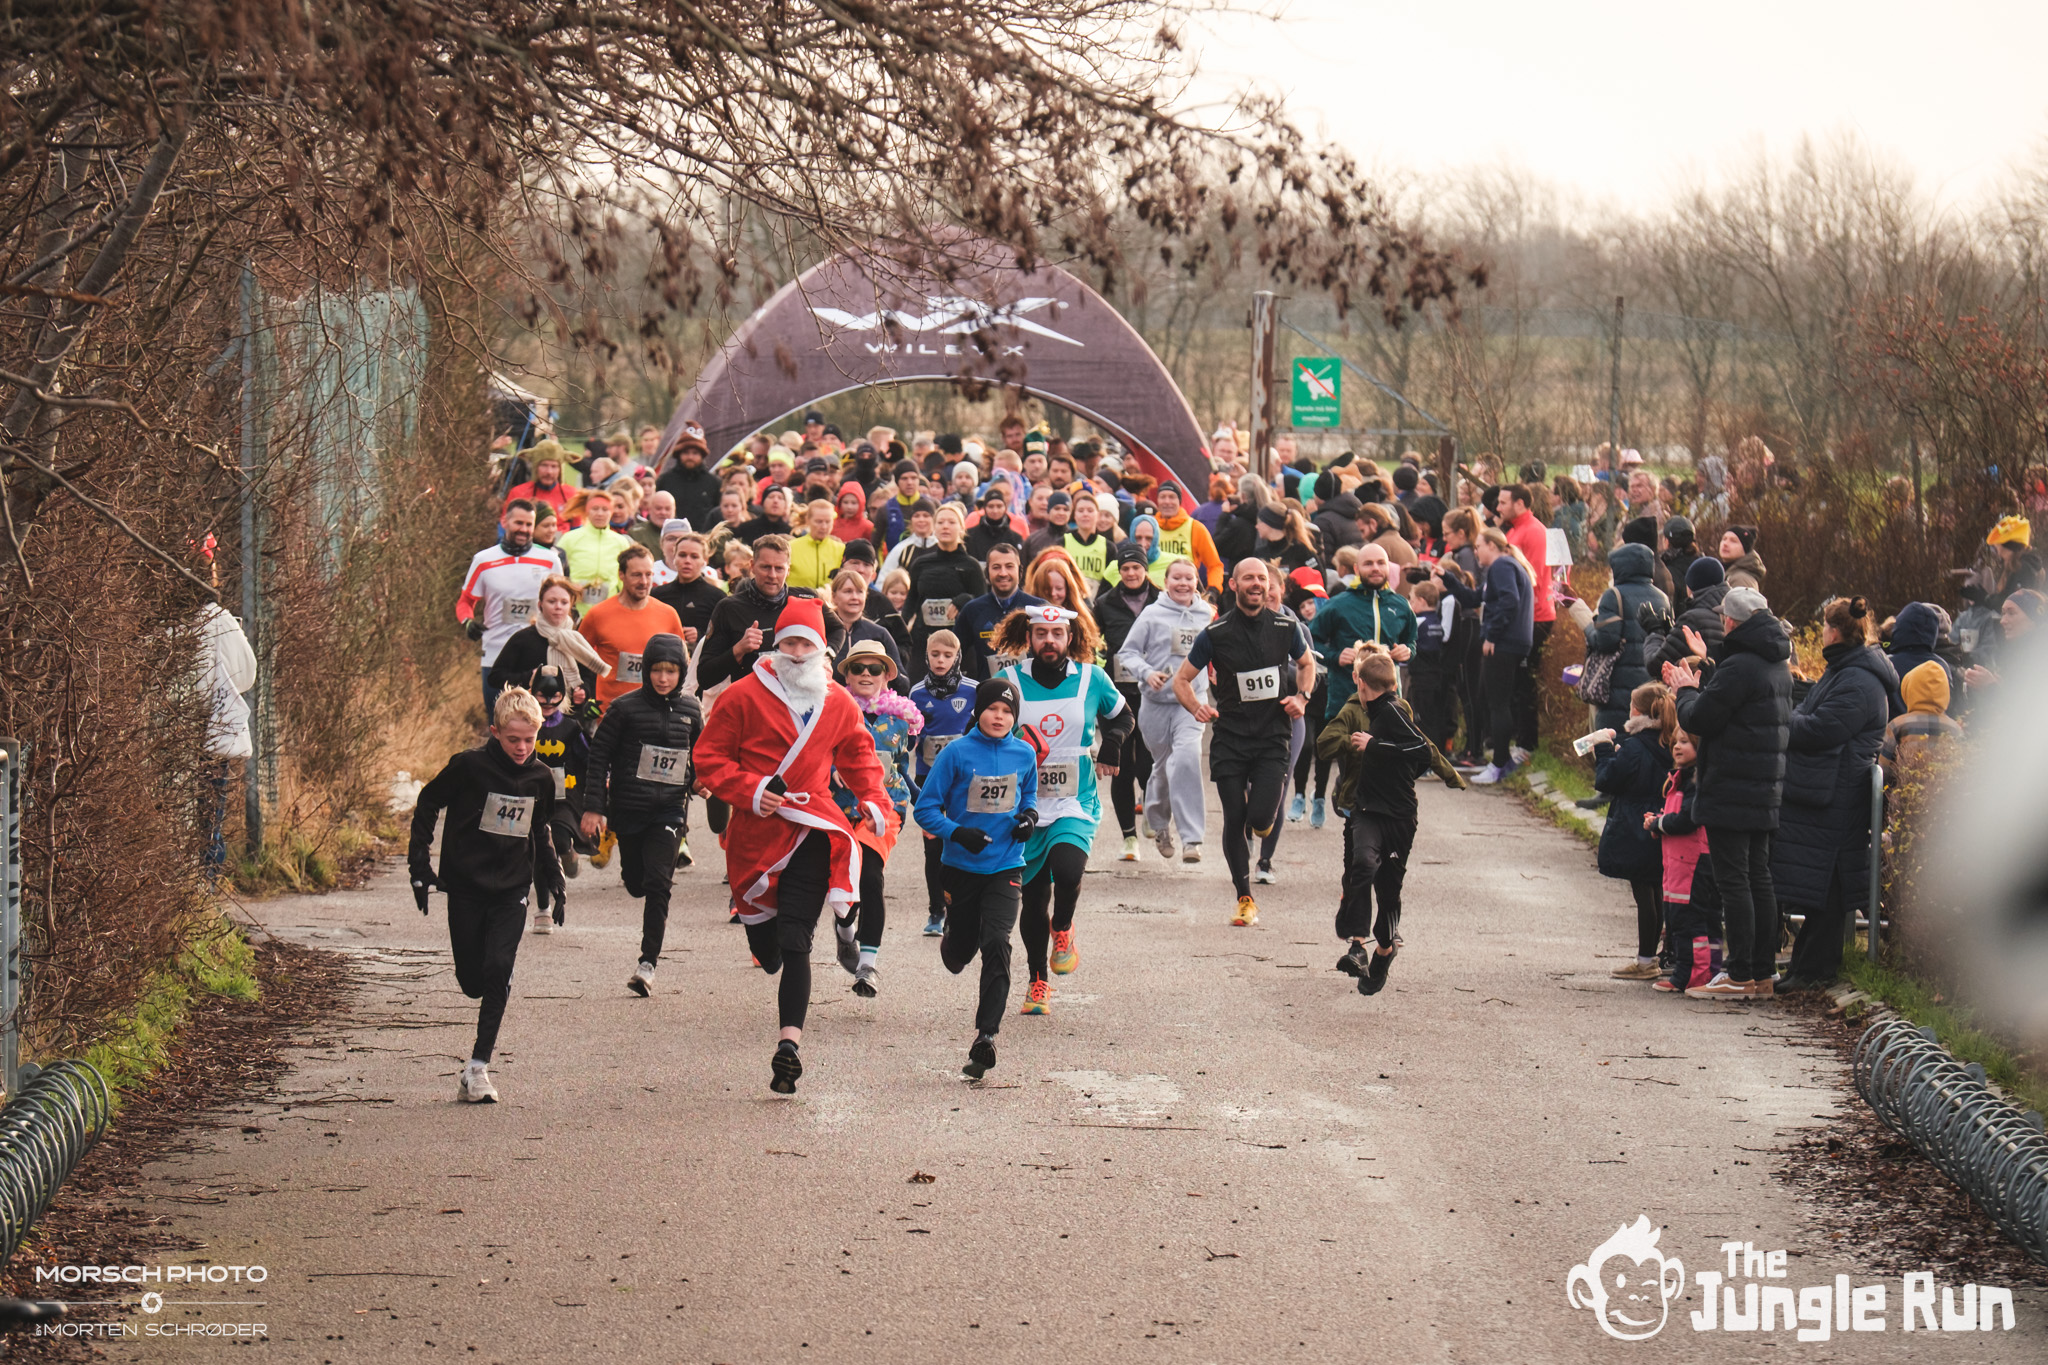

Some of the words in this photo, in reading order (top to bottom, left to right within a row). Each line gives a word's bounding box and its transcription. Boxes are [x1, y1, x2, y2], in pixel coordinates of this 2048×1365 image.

[1160, 541, 1188, 555] UIDE
[1075, 555, 1103, 573] LIND
[511, 604, 530, 614] 227
[928, 606, 945, 615] 348
[1180, 634, 1197, 645] 29
[627, 661, 642, 672] 20
[1246, 675, 1274, 691] 916
[653, 755, 677, 770] 187
[1041, 772, 1066, 785] 380
[981, 785, 1007, 799] 297
[497, 805, 525, 821] 447
